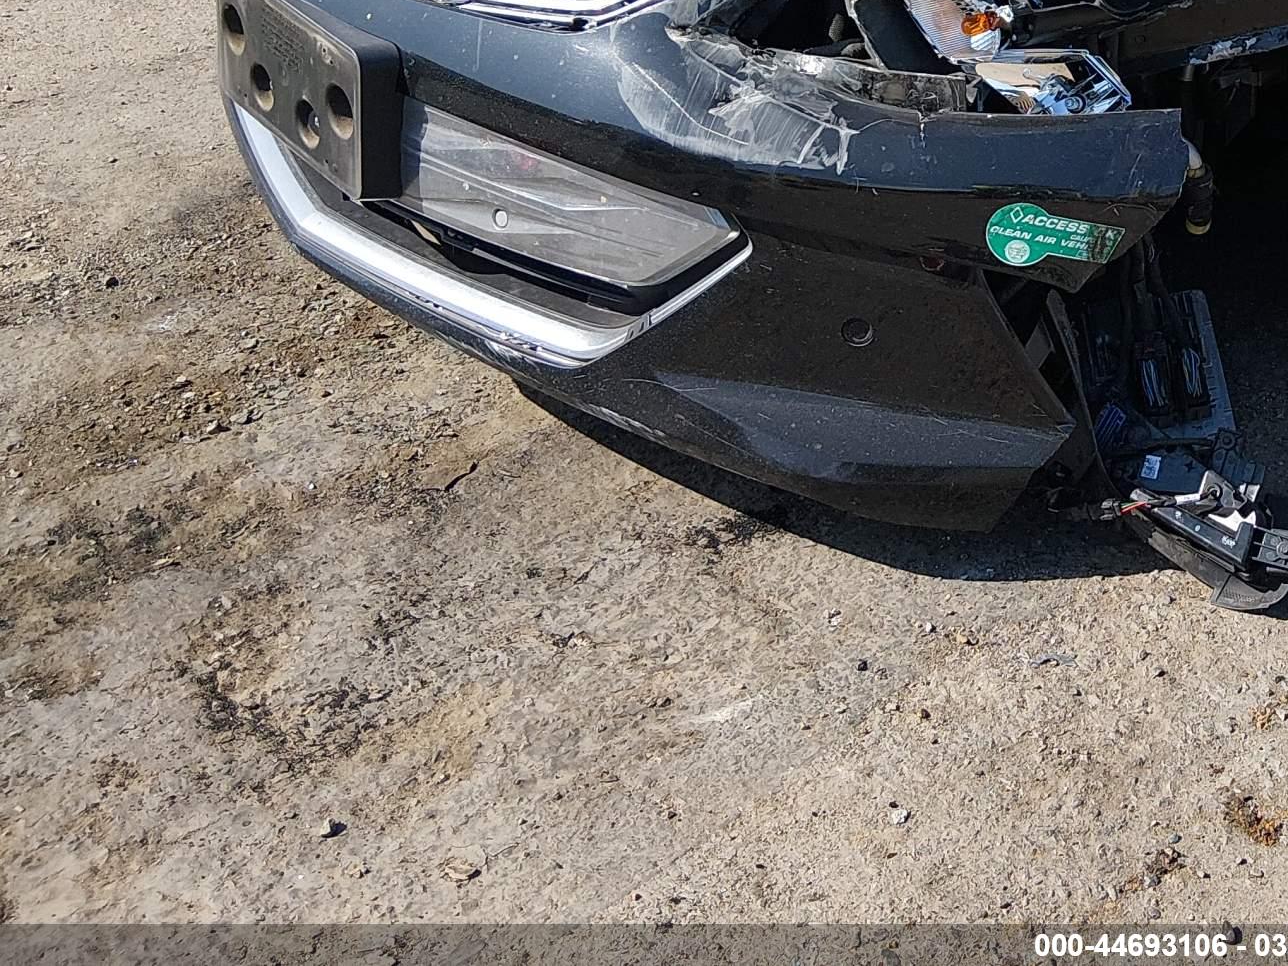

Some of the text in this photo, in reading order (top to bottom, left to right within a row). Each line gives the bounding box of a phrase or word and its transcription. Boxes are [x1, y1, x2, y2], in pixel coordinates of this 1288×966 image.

[1022, 213, 1089, 234] ACCESS
[990, 225, 1032, 239] CLEAN
[1034, 234, 1056, 244] AIR
